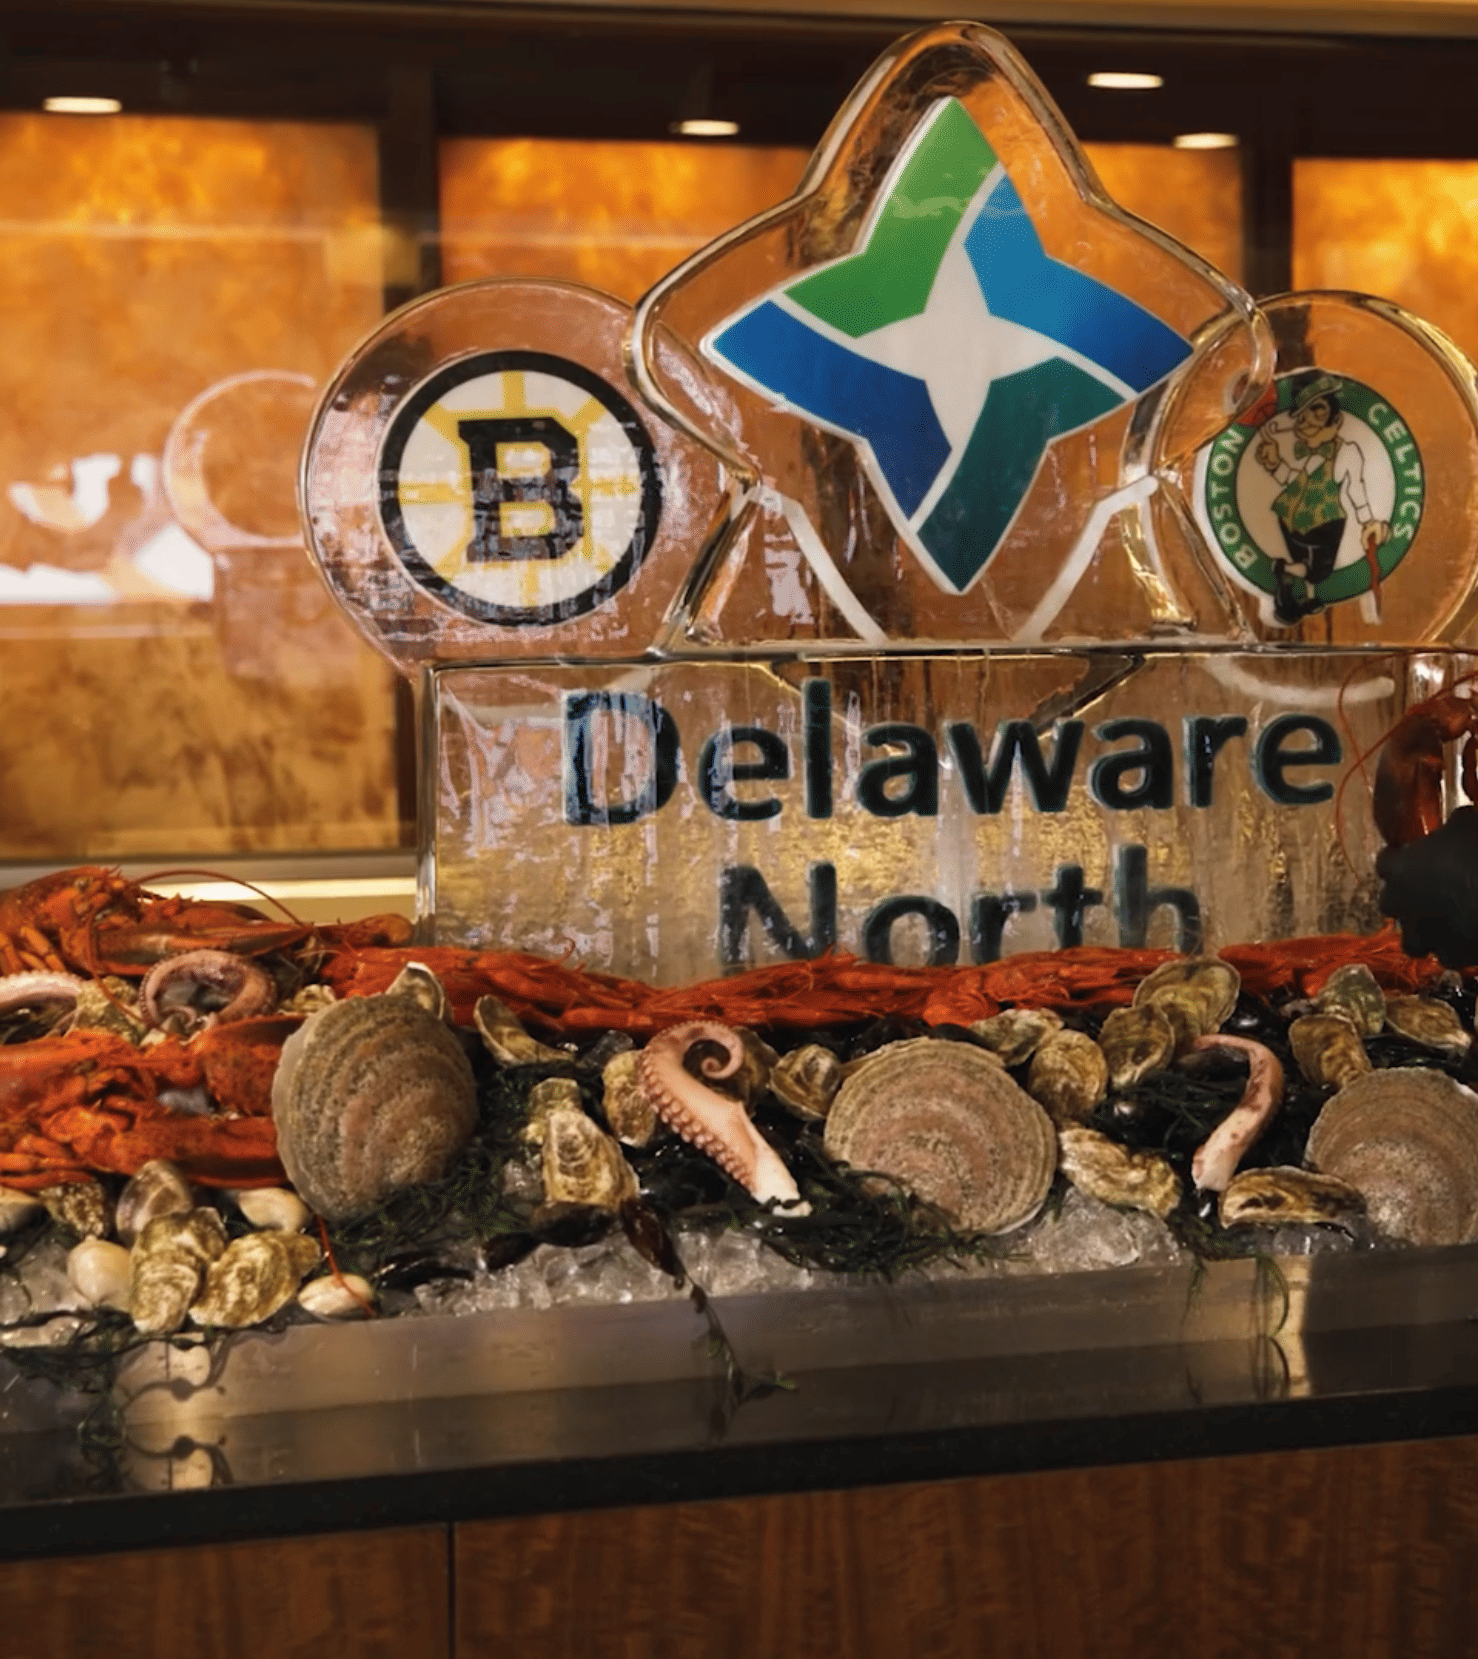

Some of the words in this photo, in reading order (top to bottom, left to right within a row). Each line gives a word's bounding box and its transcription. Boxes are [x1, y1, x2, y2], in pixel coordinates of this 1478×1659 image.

[458, 416, 584, 563] B
[1210, 428, 1258, 570] BOSTON
[1367, 402, 1421, 541] CELTICS
[562, 678, 1344, 827] Delaware
[718, 843, 1204, 977] North
